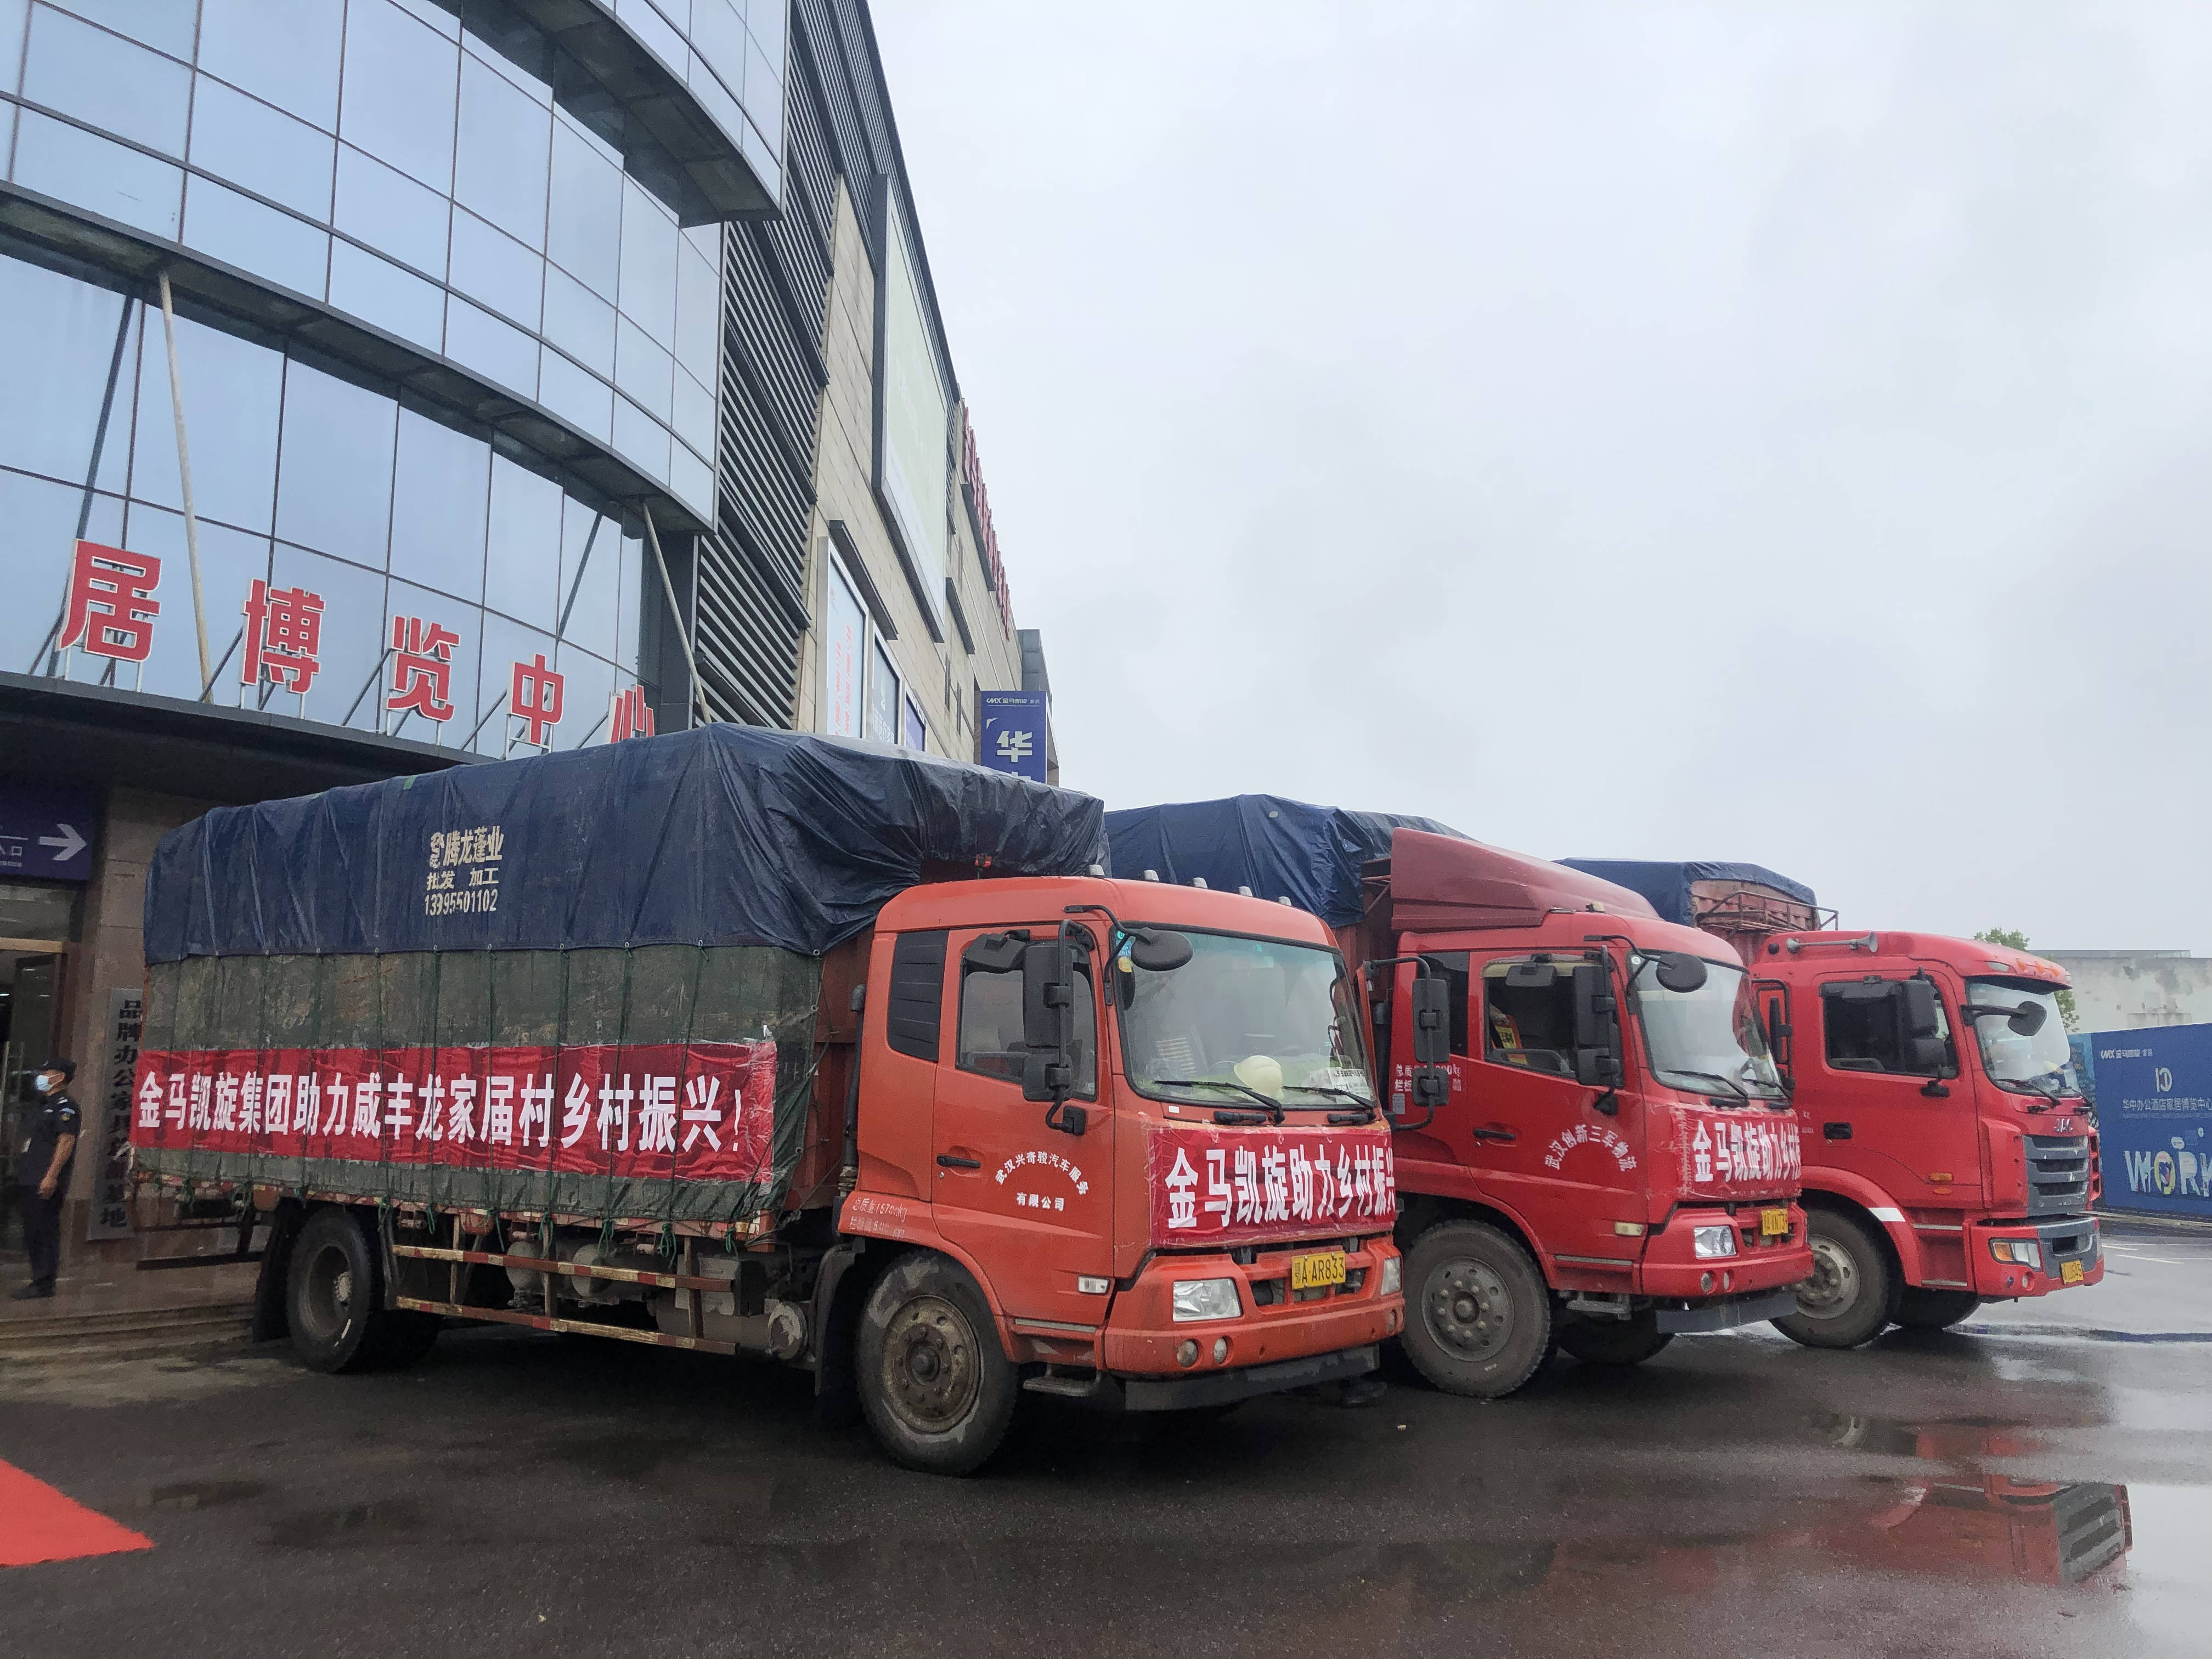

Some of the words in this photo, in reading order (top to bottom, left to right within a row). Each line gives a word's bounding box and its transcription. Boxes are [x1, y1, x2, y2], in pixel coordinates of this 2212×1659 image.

[427, 870, 455, 891] 批发
[469, 867, 499, 887] 加工
[1165, 1143, 1396, 1228] 金马凯旋助力乡村振兴
[1017, 1192, 1064, 1211] 有限公司
